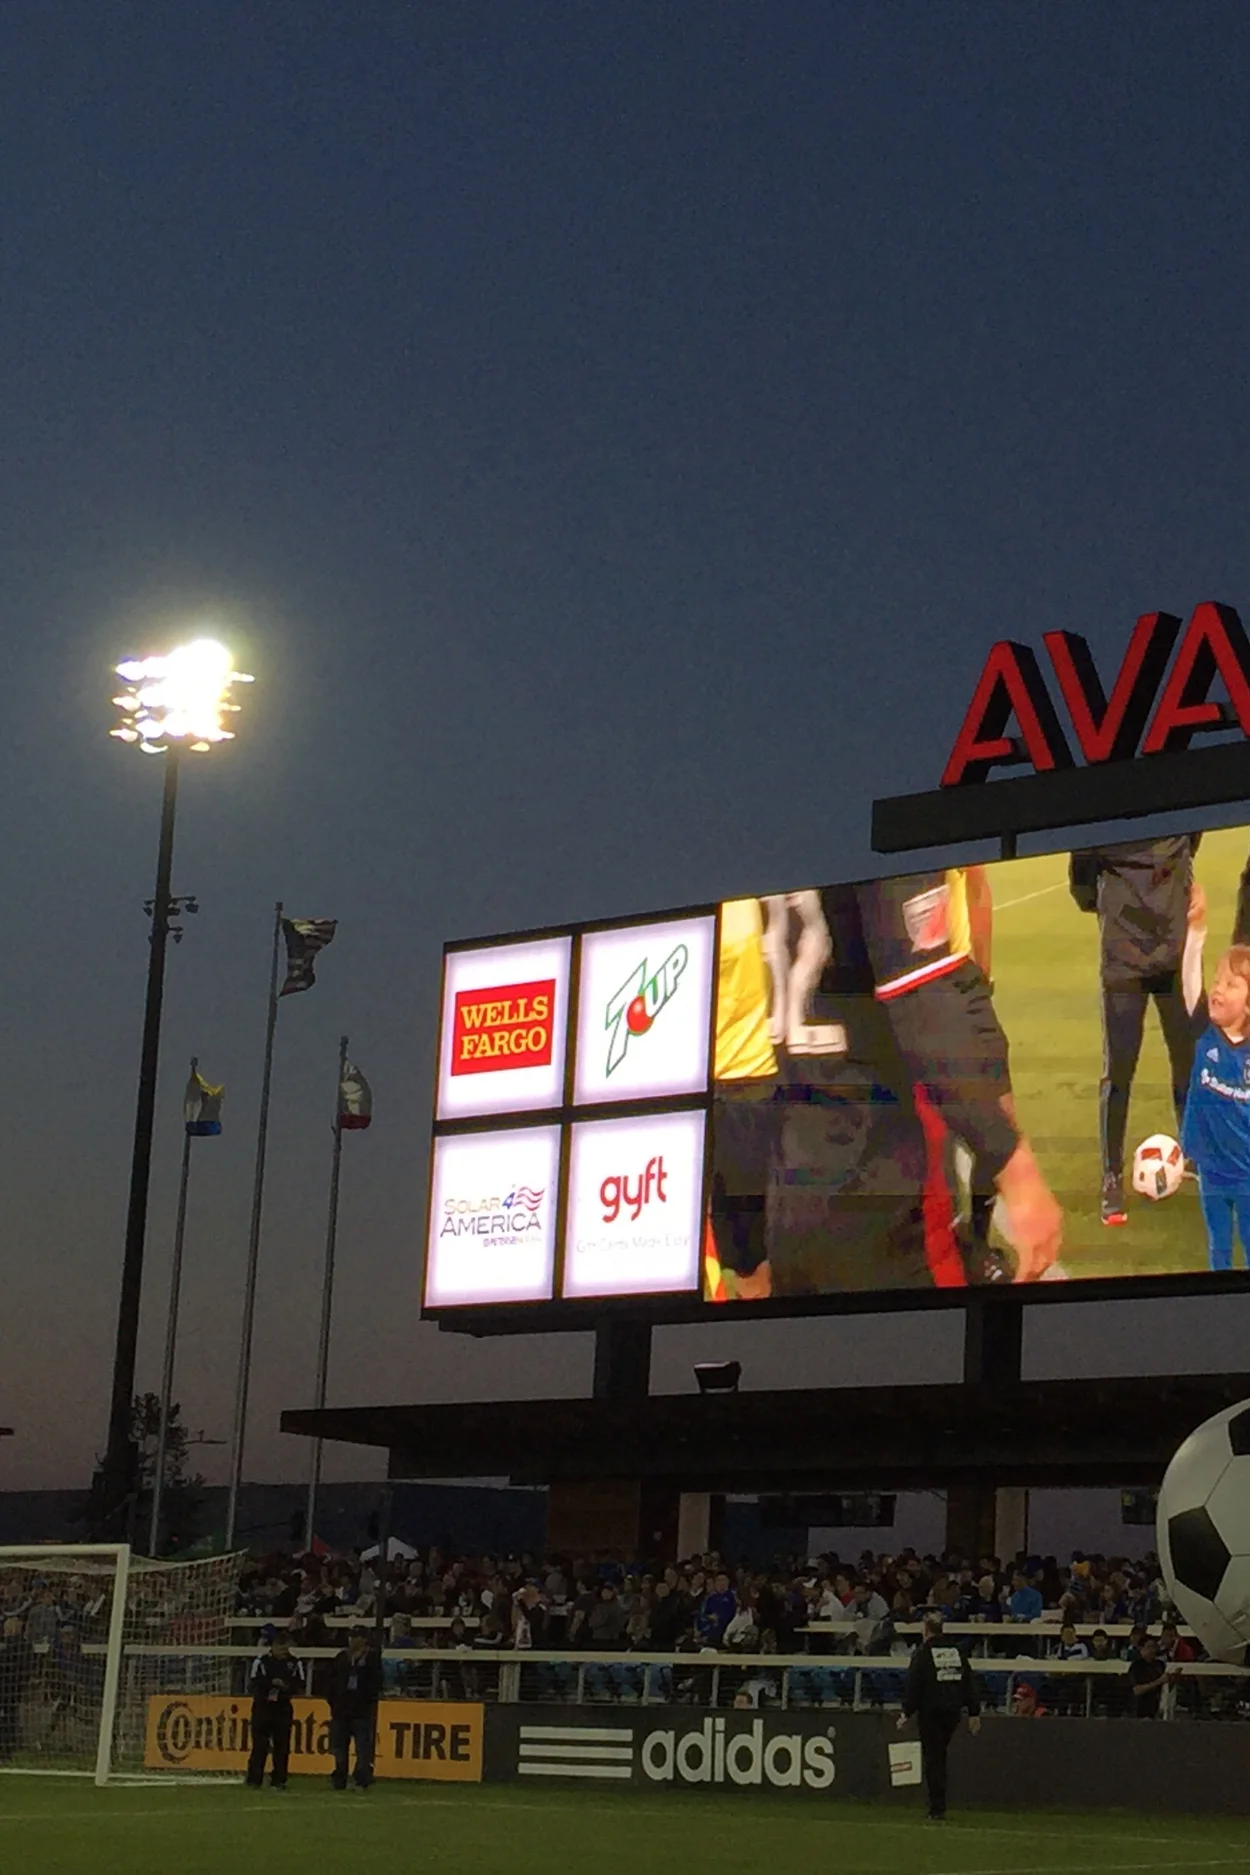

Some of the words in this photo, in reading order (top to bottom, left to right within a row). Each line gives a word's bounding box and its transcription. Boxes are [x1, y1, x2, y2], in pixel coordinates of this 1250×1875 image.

[460, 995, 549, 1030] WELLS
[604, 943, 688, 1078] 7UP
[460, 1026, 547, 1060] FARGO
[444, 1197, 500, 1215] SOLAR
[502, 1192, 515, 1210] 4
[600, 1155, 668, 1224] gyft
[440, 1212, 542, 1238] AMERICA
[156, 1700, 383, 1765] Continta
[389, 1722, 471, 1762] TIRE
[642, 1716, 836, 1789] adidas
